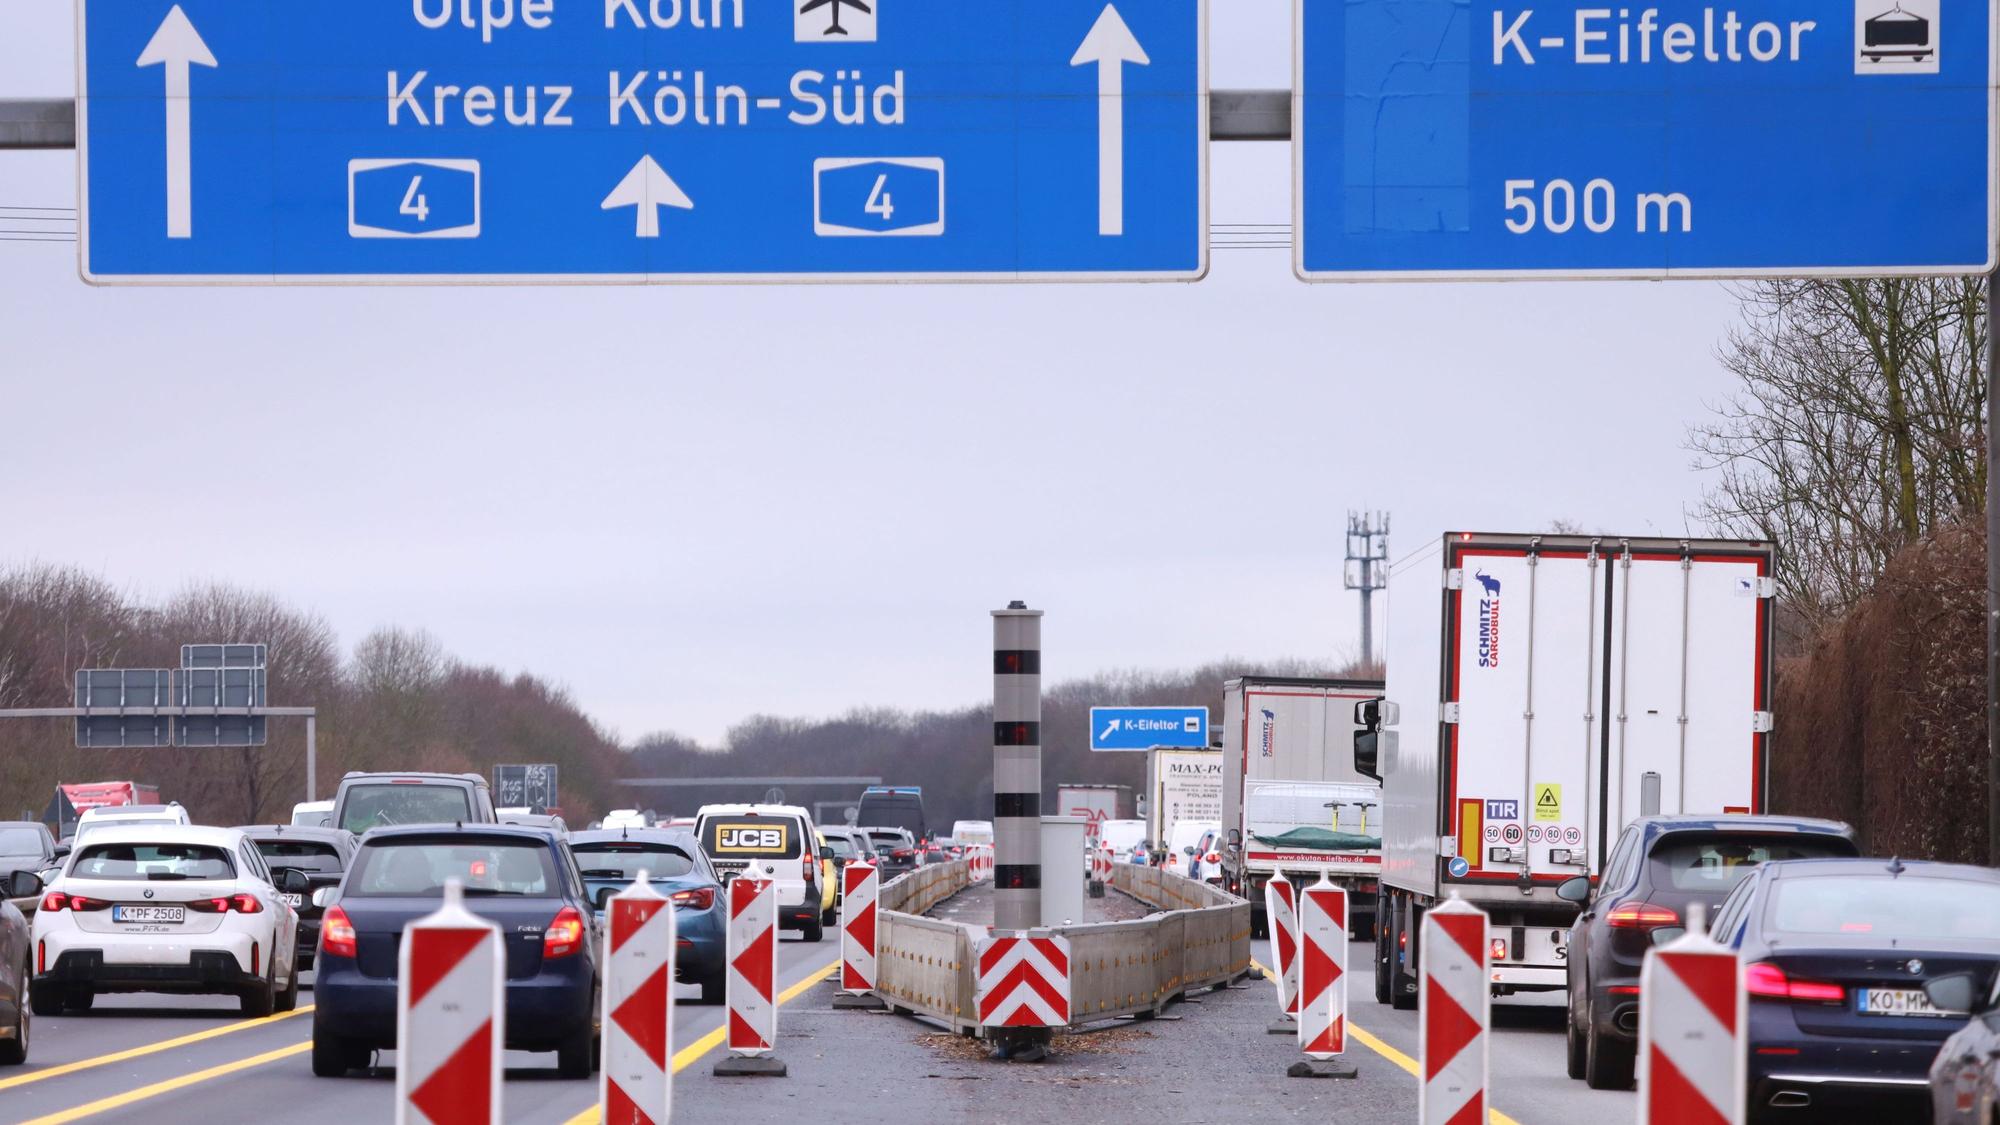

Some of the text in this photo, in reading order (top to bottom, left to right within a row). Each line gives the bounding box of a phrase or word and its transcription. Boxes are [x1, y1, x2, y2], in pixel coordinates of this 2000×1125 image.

[1492, 7, 1817, 65] K-Eifeltor
[387, 69, 905, 126] Kreuz Köln-Süd
[399, 175, 429, 221] 4
[864, 174, 894, 220] 4
[1504, 178, 1692, 234] 500 m
[1479, 599, 1490, 667] SCHMITZ
[1490, 599, 1499, 668] CARGOBULL
[1124, 719, 1179, 730] K-Eifeltor
[1488, 802, 1516, 818] TIR
[721, 829, 781, 847] JCB
[1487, 829, 1498, 838] 50
[1506, 828, 1519, 839] 60
[1528, 829, 1540, 838] 70
[1547, 830, 1559, 839] 80
[1566, 831, 1578, 840] 90
[1276, 854, 1364, 863] www.okutan-tiefbau.de
[120, 907, 182, 920] K PF 2508
[1869, 991, 1894, 1009] KO
